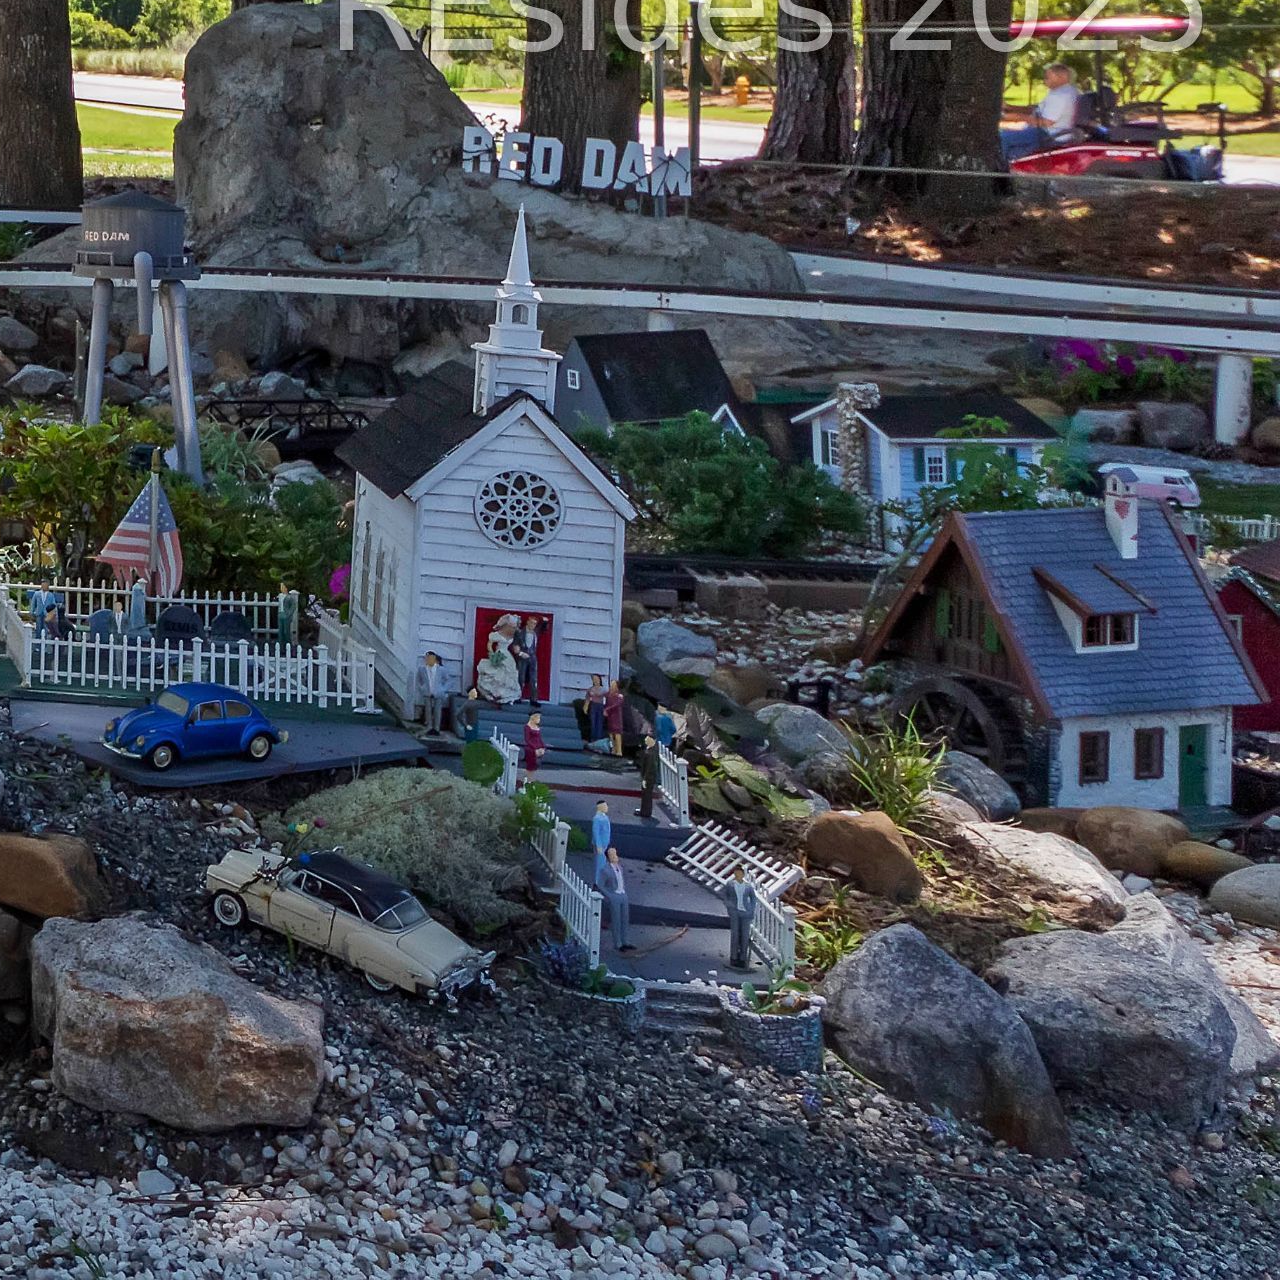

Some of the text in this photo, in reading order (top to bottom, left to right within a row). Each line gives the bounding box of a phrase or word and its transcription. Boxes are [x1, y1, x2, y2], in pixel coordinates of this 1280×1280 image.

[462, 125, 692, 197] RED DAM
[84, 230, 130, 241] RED DAM
